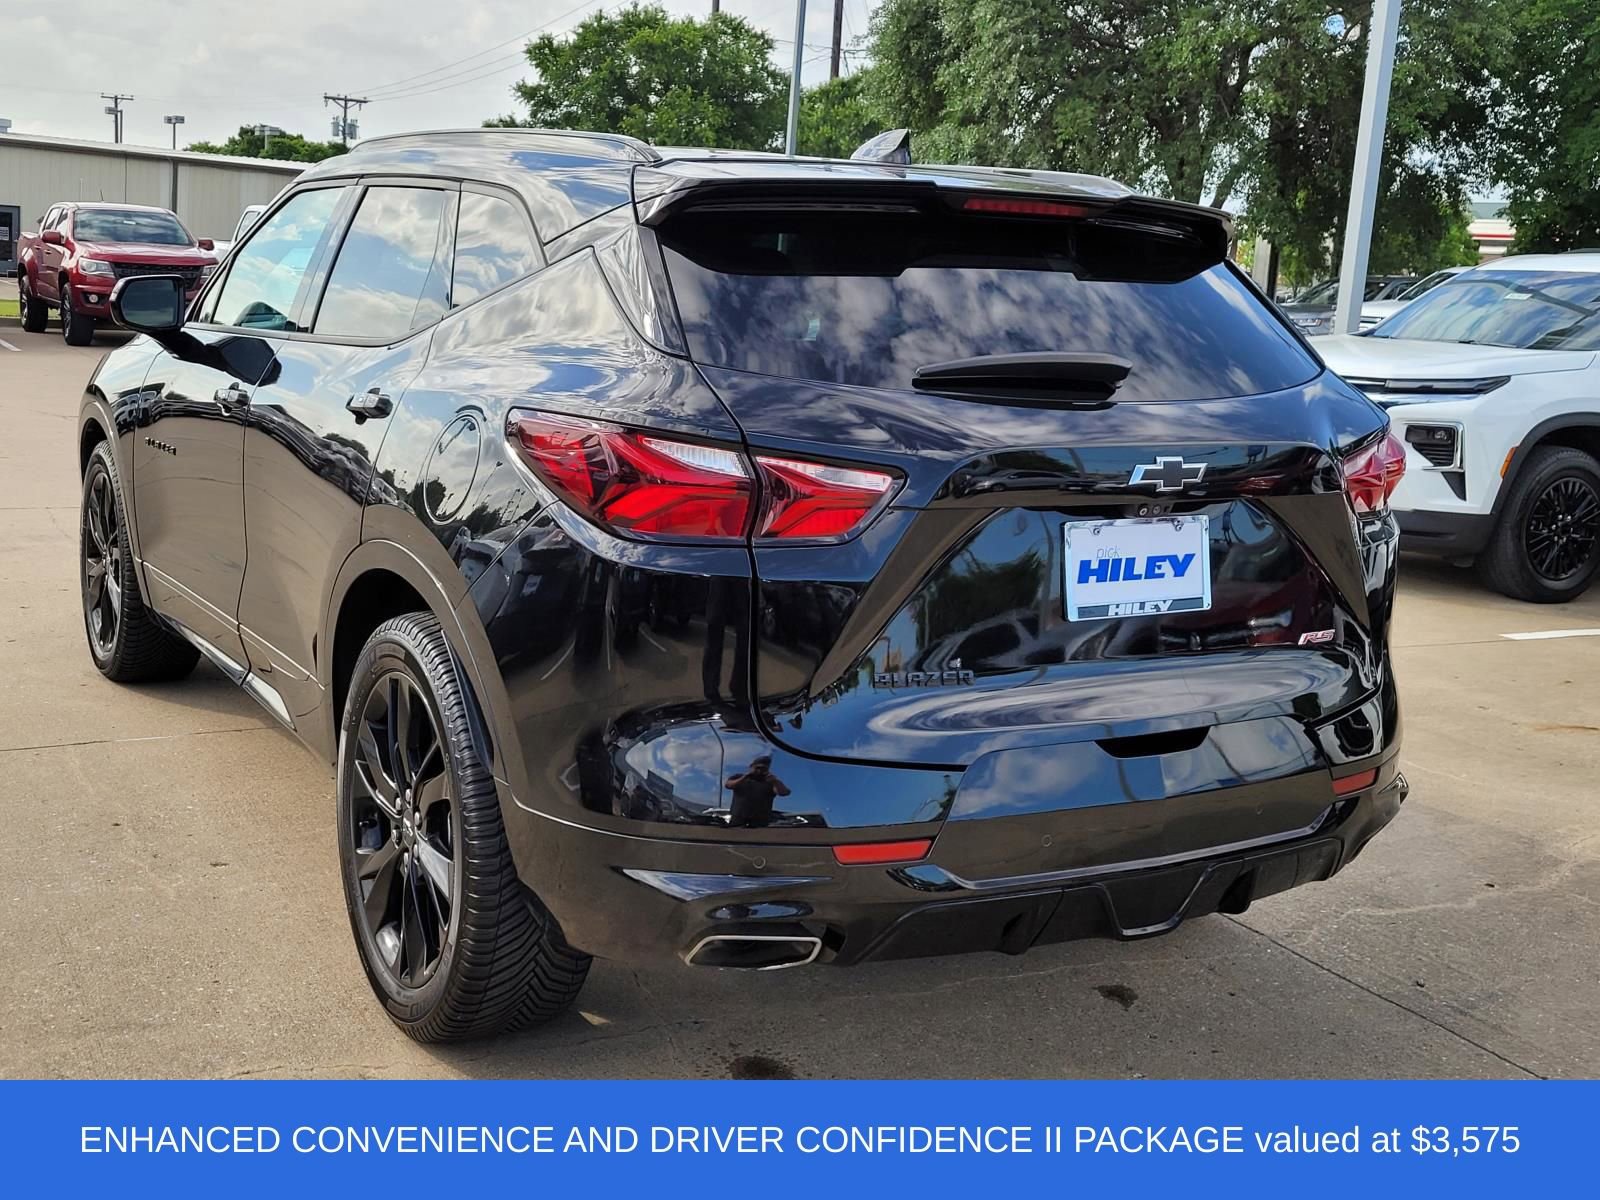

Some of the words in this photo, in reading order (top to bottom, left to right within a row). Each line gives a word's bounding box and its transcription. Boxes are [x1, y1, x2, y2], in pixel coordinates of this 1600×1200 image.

[1096, 545, 1121, 560] pick
[1077, 553, 1196, 585] HILEY
[1107, 599, 1174, 617] HILEY
[1298, 629, 1336, 646] RS
[872, 669, 976, 689] BLAZER
